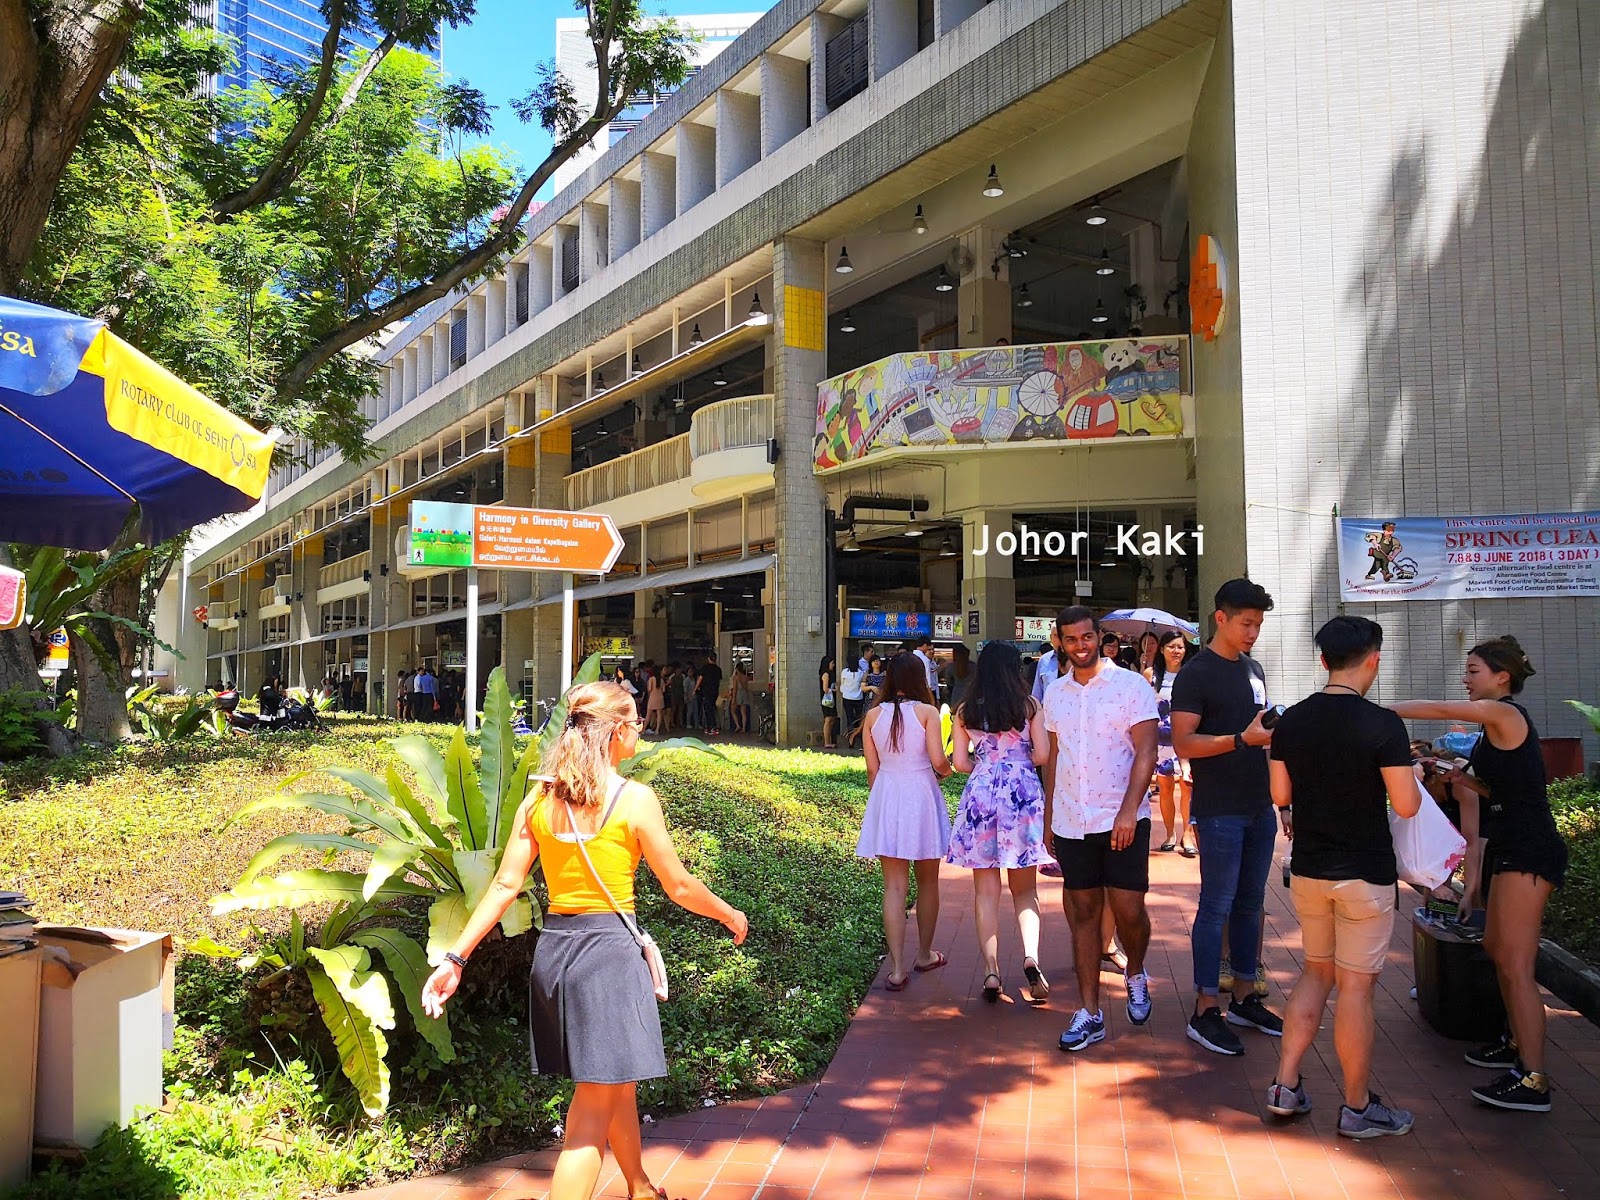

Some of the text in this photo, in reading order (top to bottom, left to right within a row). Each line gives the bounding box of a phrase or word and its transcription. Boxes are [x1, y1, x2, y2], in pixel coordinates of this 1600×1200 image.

[0, 320, 37, 358] SA
[121, 379, 163, 416] ROTARY
[192, 419, 203, 440] OF
[479, 511, 600, 531] Harmony in Diversity Gallery
[1446, 518, 1468, 528] This
[1470, 517, 1507, 527] Centre
[1510, 515, 1530, 526] will
[1532, 516, 1545, 525] be
[1547, 514, 1580, 524] closed
[1445, 528, 1599, 549] SPRING CLEA
[1484, 552, 1513, 563] JUNE
[1518, 550, 1546, 562] 2018
[935, 616, 953, 631] 香香
